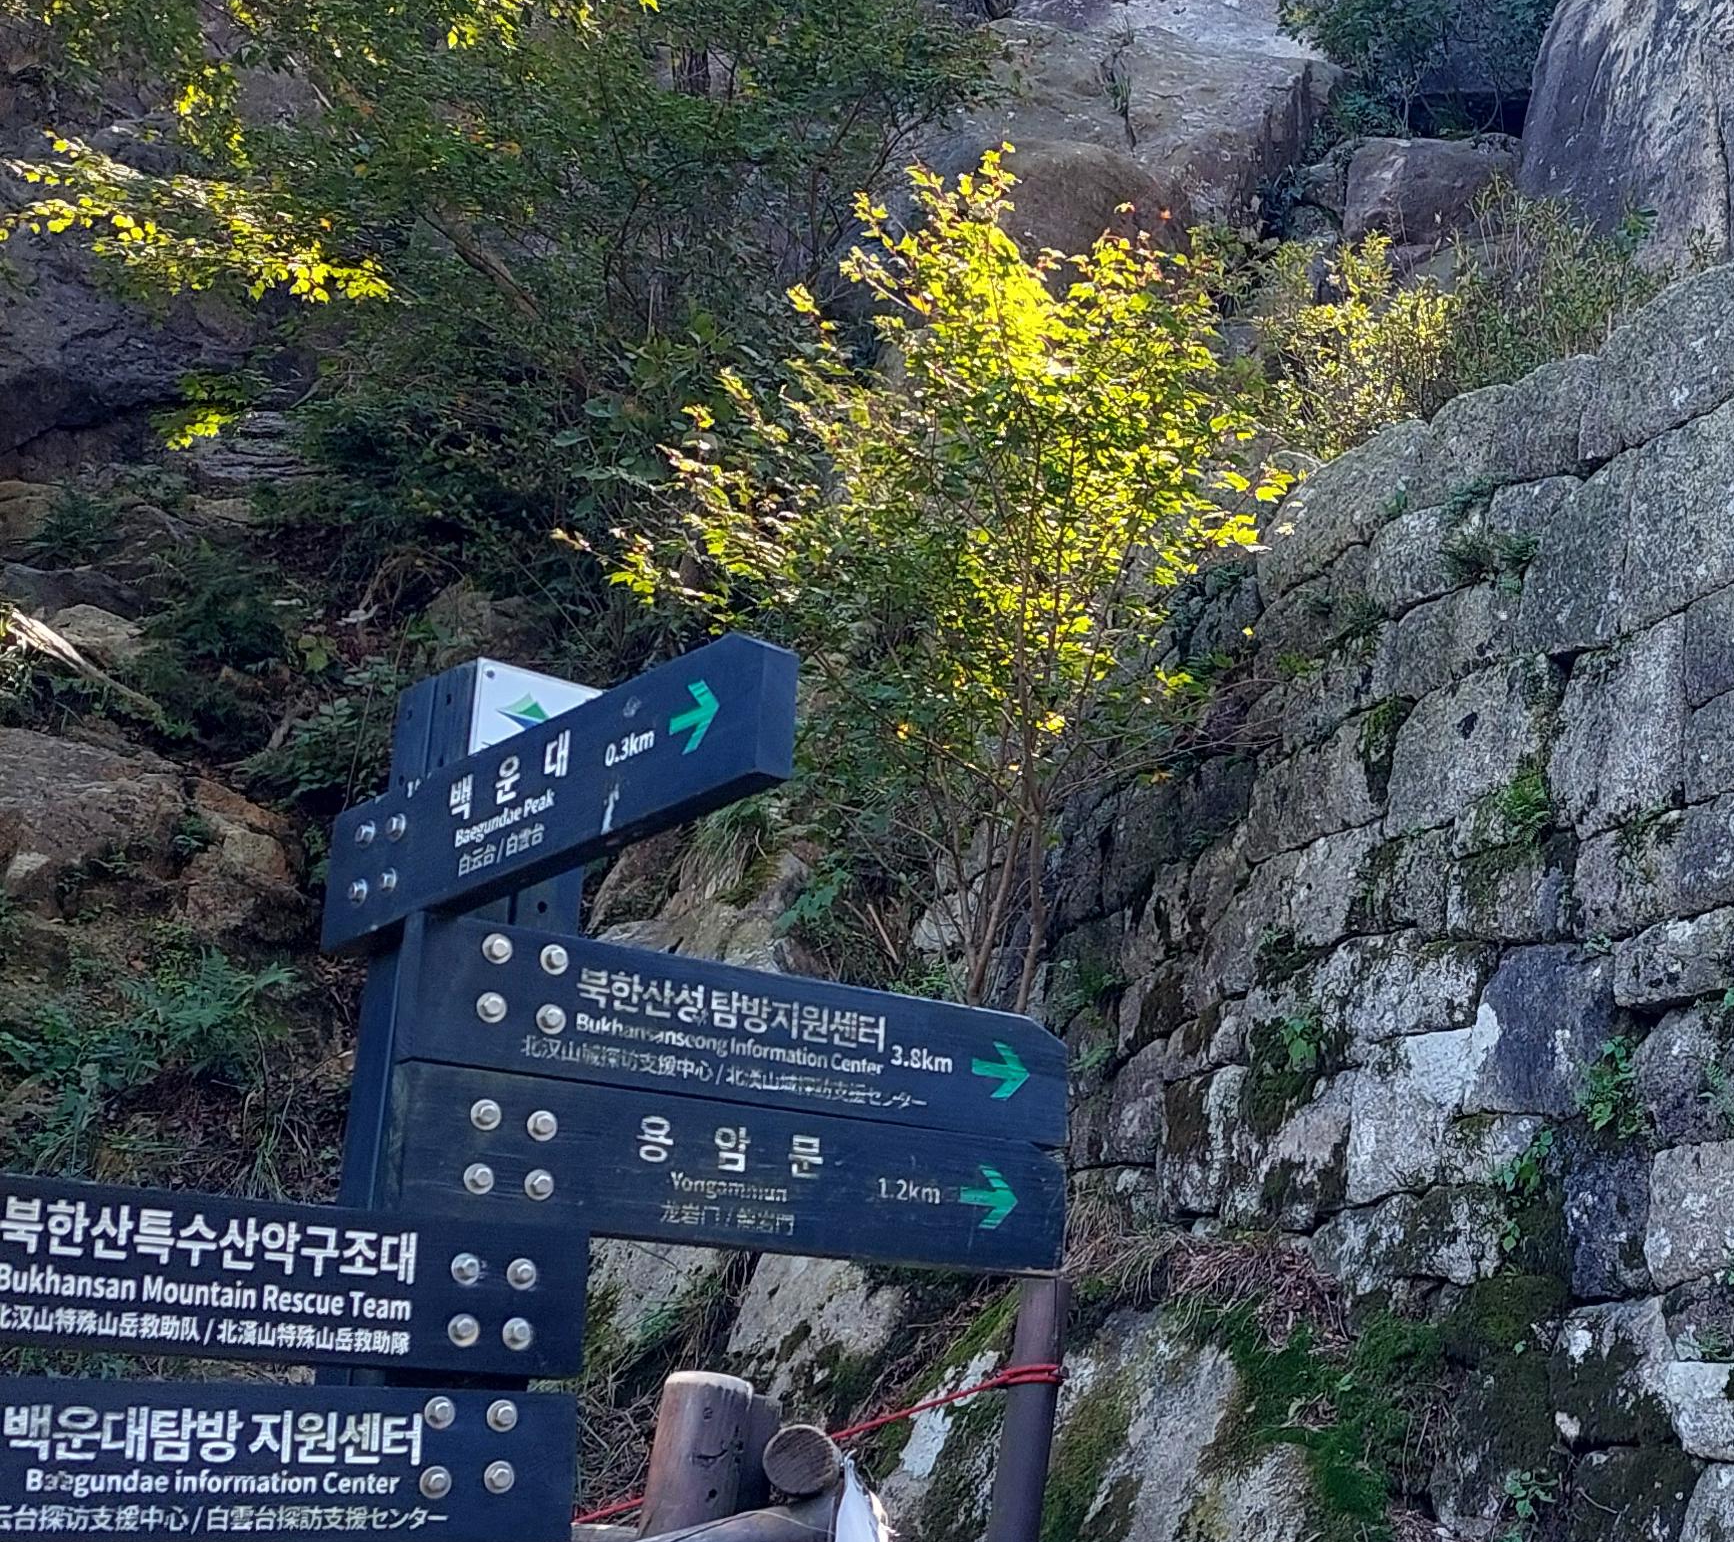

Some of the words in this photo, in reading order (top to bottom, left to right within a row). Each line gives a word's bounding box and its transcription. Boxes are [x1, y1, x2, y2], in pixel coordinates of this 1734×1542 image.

[604, 729, 655, 767] 0.3km
[455, 805, 522, 848] Baegundae
[523, 788, 555, 818] Peak
[730, 1036, 828, 1070] Information
[831, 1052, 884, 1075] Center
[889, 1045, 953, 1074] 3.8km
[878, 1177, 941, 1205] 1.2km
[0, 1195, 418, 1285] 북한산특수산악구조대
[0, 1262, 136, 1301] Bukhansan
[142, 1274, 257, 1310] Mountain
[262, 1284, 345, 1316] Rescue
[349, 1290, 412, 1321] Team
[26, 1468, 169, 1498] Baegundae
[174, 1468, 318, 1494] information
[322, 1470, 400, 1495] Center
